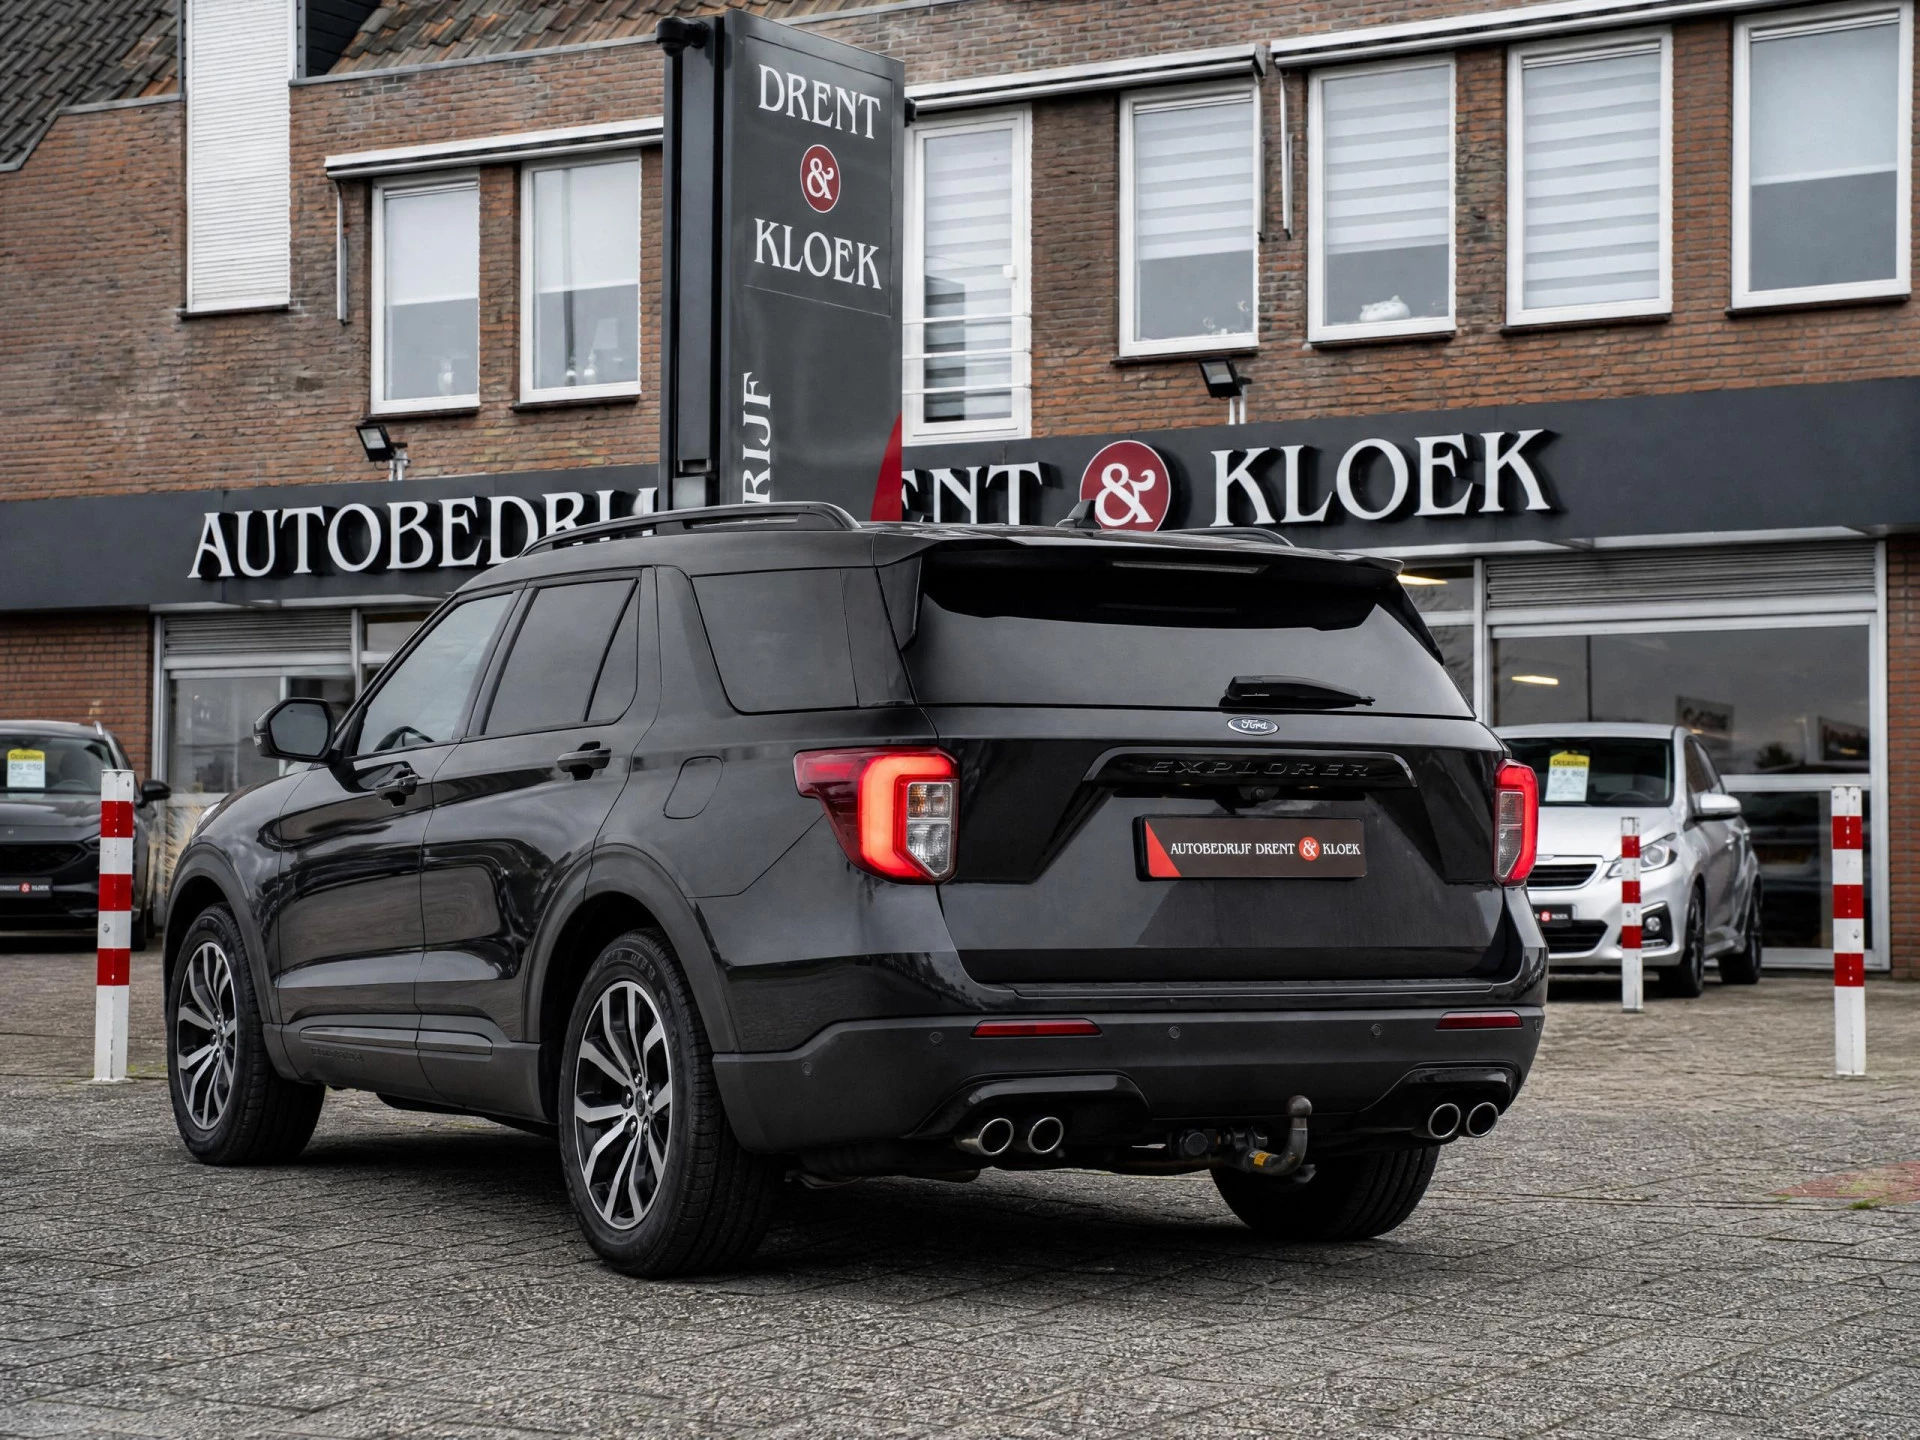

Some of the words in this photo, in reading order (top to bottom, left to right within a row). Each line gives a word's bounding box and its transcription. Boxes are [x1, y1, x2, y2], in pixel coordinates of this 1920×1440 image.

[757, 63, 882, 139] DRENT
[806, 157, 835, 201] &
[754, 217, 883, 290] KLOEK
[1095, 461, 1157, 528] &
[1209, 428, 1552, 528] KLOEK
[1241, 719, 1268, 729] Ford
[10, 752, 43, 761] Occasion
[1552, 759, 1587, 767] Occasion
[1147, 760, 1369, 777] EXPLORER
[1170, 842, 1251, 855] AUTOBEDRIJF
[1255, 843, 1296, 855] DRENT
[1302, 839, 1317, 857] &
[1322, 843, 1361, 855] KLOEK
